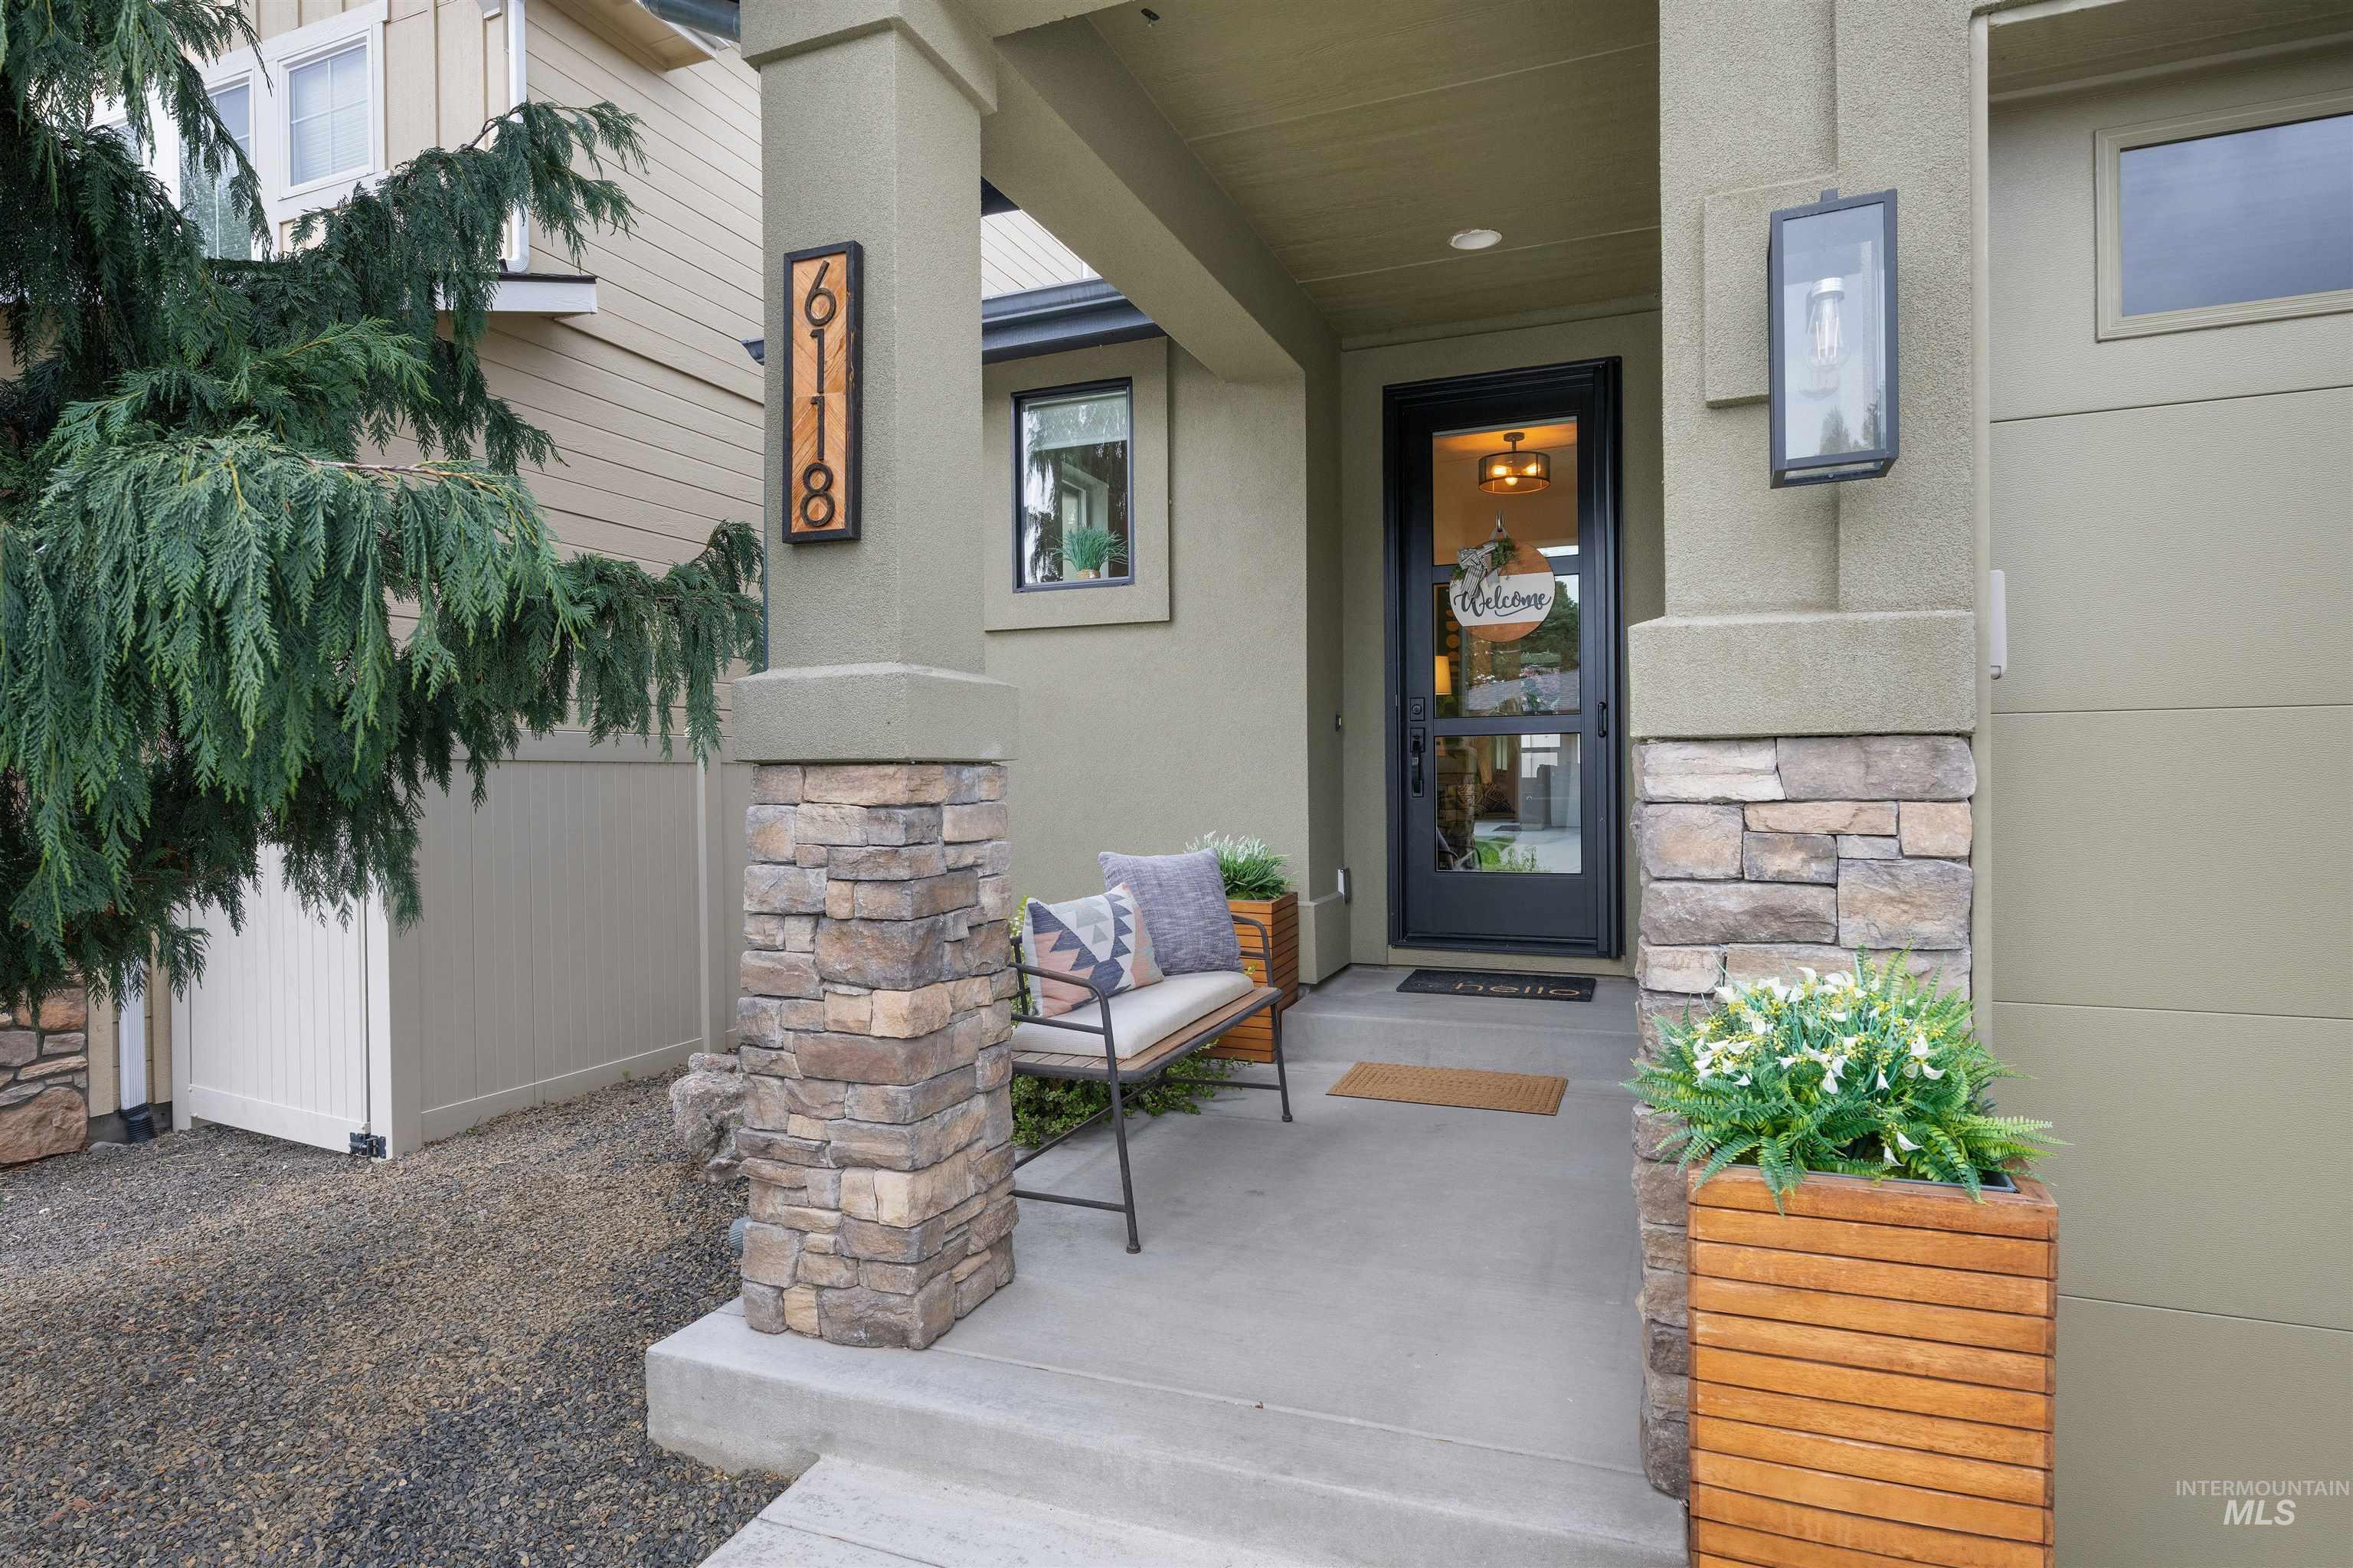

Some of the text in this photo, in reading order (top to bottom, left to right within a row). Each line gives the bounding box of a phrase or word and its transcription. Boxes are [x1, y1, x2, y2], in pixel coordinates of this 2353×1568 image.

[799, 259, 836, 528] 6118
[1454, 585, 1551, 617] Welcome
[1454, 982, 1581, 997] hello
